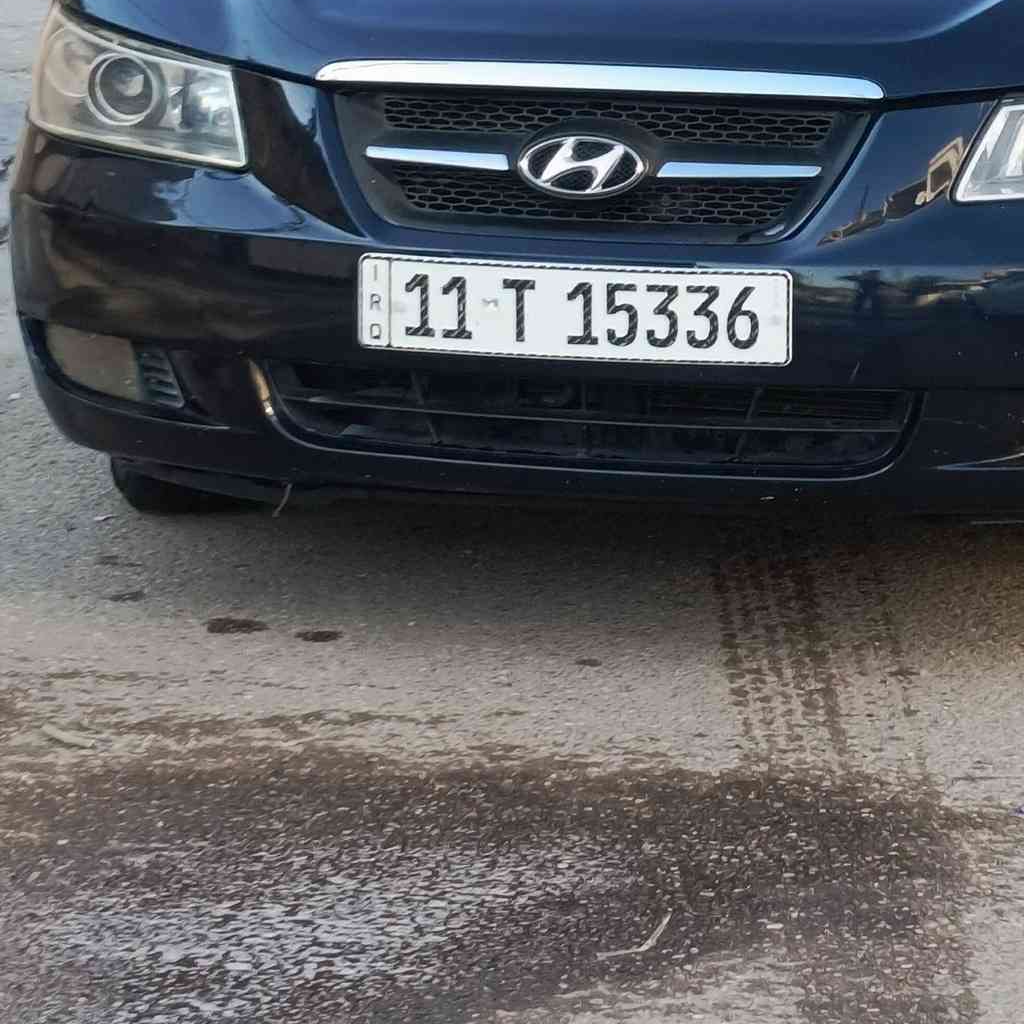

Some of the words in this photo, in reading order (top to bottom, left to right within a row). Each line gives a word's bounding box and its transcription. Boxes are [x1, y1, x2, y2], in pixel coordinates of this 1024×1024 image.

[404, 273, 473, 340] 11
[502, 278, 536, 343] T
[566, 281, 760, 350] 15336
